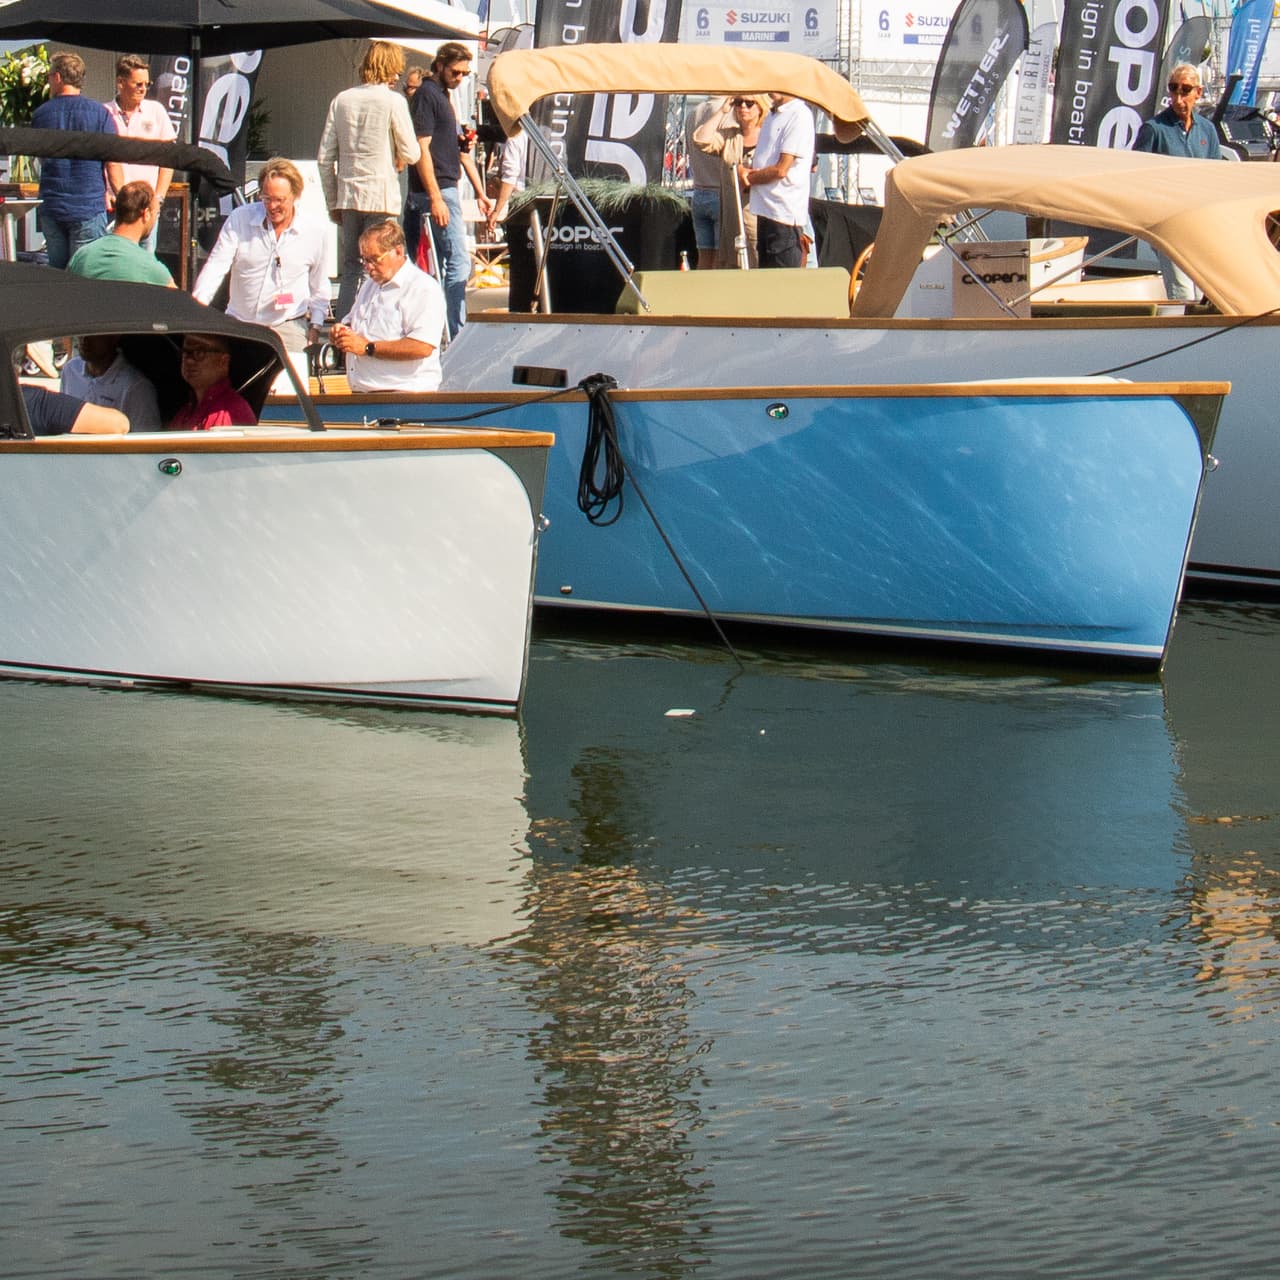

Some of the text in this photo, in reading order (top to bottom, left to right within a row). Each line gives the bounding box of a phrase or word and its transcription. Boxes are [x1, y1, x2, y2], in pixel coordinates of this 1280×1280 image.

[696, 7, 710, 30] 6
[740, 12, 791, 24] SUZUKI
[805, 7, 819, 30] 6
[878, 9, 890, 31] 6
[740, 31, 776, 41] MARINE
[1078, 43, 1104, 72] in
[941, 33, 1010, 139] WETTER
[972, 72, 1000, 114] BOATS
[1066, 79, 1094, 144] boati
